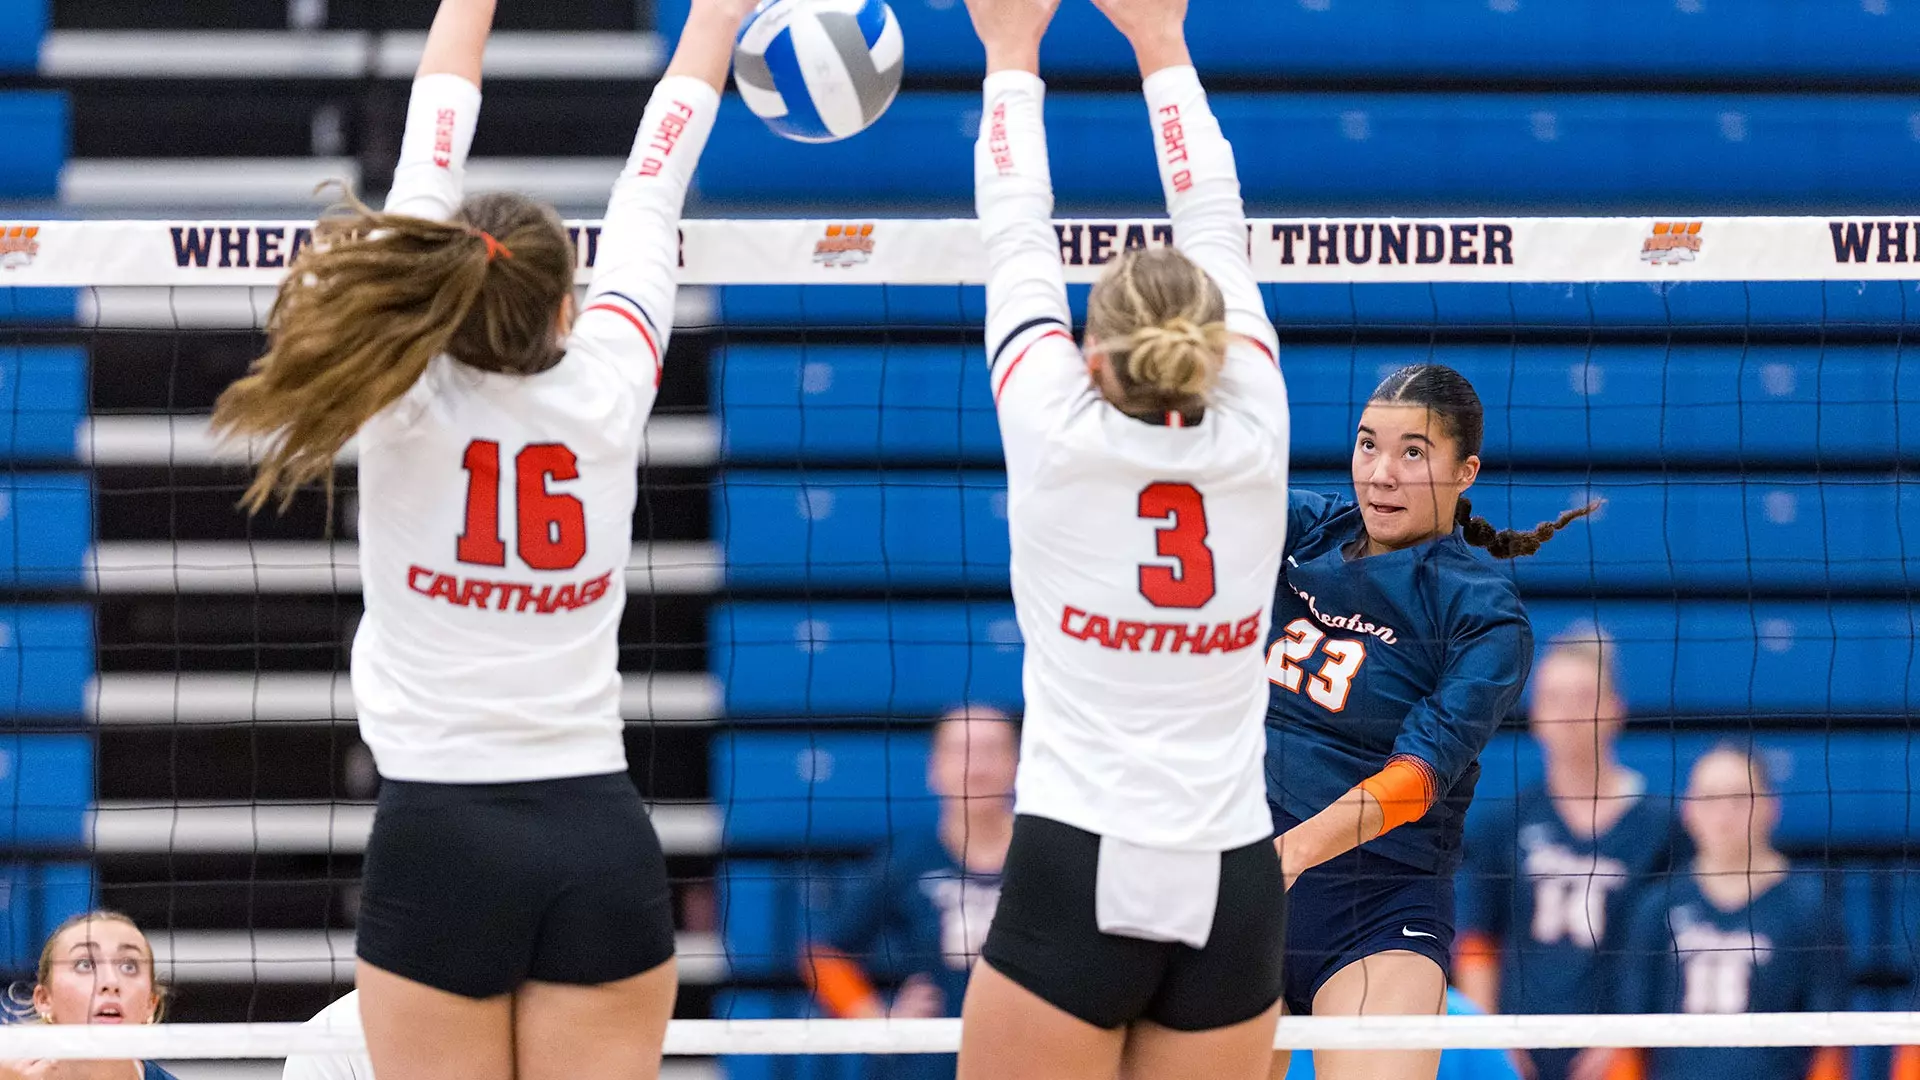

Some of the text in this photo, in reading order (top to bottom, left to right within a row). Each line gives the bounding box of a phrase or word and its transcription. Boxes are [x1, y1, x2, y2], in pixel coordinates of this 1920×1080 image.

[649, 99, 694, 157] FIGHT
[1159, 103, 1189, 165] FIGHT
[170, 226, 313, 268] WHEA
[1272, 223, 1514, 266] THUNDER
[1829, 221, 1920, 264] WH
[456, 438, 587, 571] 16
[1137, 480, 1217, 609] 3
[1288, 582, 1398, 645] heaton
[1265, 617, 1367, 713] 23
